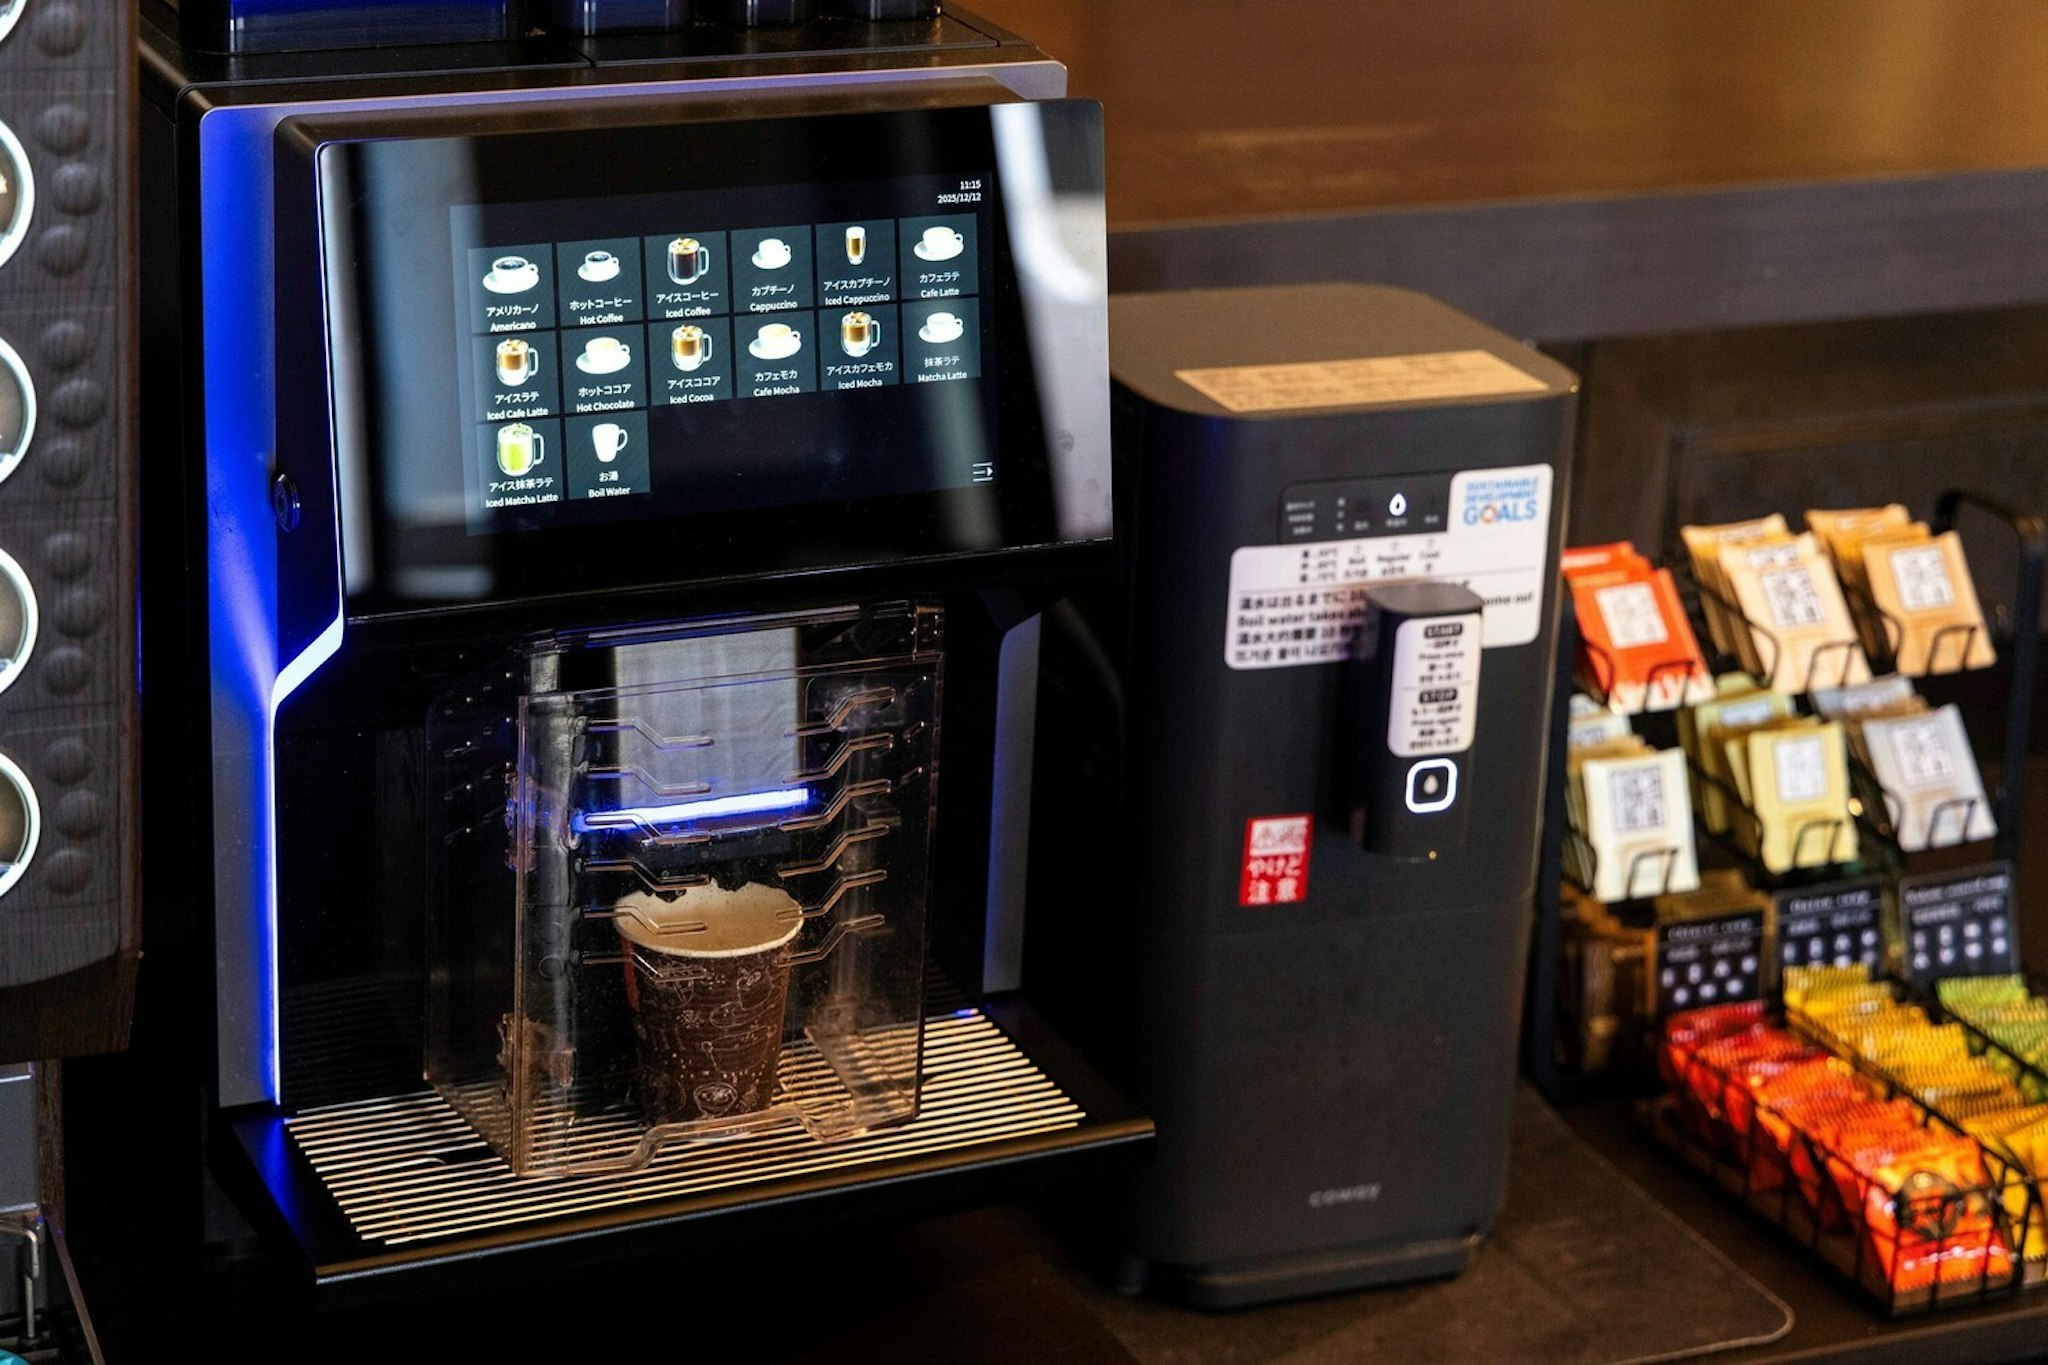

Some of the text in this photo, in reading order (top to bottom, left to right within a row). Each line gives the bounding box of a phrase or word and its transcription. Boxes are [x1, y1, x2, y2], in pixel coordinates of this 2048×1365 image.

[960, 180, 982, 190] 11:15
[937, 192, 982, 204] 2025/12/12
[824, 277, 891, 291] アイスカプチーノ
[919, 271, 960, 284] カフェラテ
[751, 284, 795, 297] カプチーノ
[920, 287, 960, 299] Cafe Latte
[569, 298, 632, 311] ホットコーヒー
[656, 292, 719, 304] アイスコーヒー
[825, 293, 890, 307] Iced Cappuccino
[486, 304, 539, 317] アメリカーノ
[665, 307, 711, 319] Iced Coffee
[749, 300, 798, 313] Cappuccino
[579, 314, 624, 325] Hot Coffee
[490, 321, 537, 333] Americano
[924, 355, 960, 368] 抹茶ラテ
[826, 362, 894, 376] アイスカフェモカ
[754, 369, 798, 383] カフェモカ
[917, 370, 968, 383] Matcha Latte
[667, 376, 721, 390] アイスココア
[837, 378, 883, 390] Iced Mocha
[494, 391, 540, 404] アイスラテ
[578, 384, 632, 398] ホットココア
[753, 385, 800, 397] Cafe Mocha
[669, 393, 714, 404] Iced Cocoa
[576, 399, 635, 413] Hot Chocolate
[487, 407, 549, 421] Iced Cafe Latte
[598, 471, 619, 483] お湯
[489, 477, 554, 493] アイス抹茶ラテ
[588, 486, 631, 498] Boil Water
[485, 493, 558, 509] Iced Matcha Latte
[1462, 500, 1538, 527] GOALS
[1246, 855, 1304, 879] やけど
[1248, 878, 1298, 905] 注意
